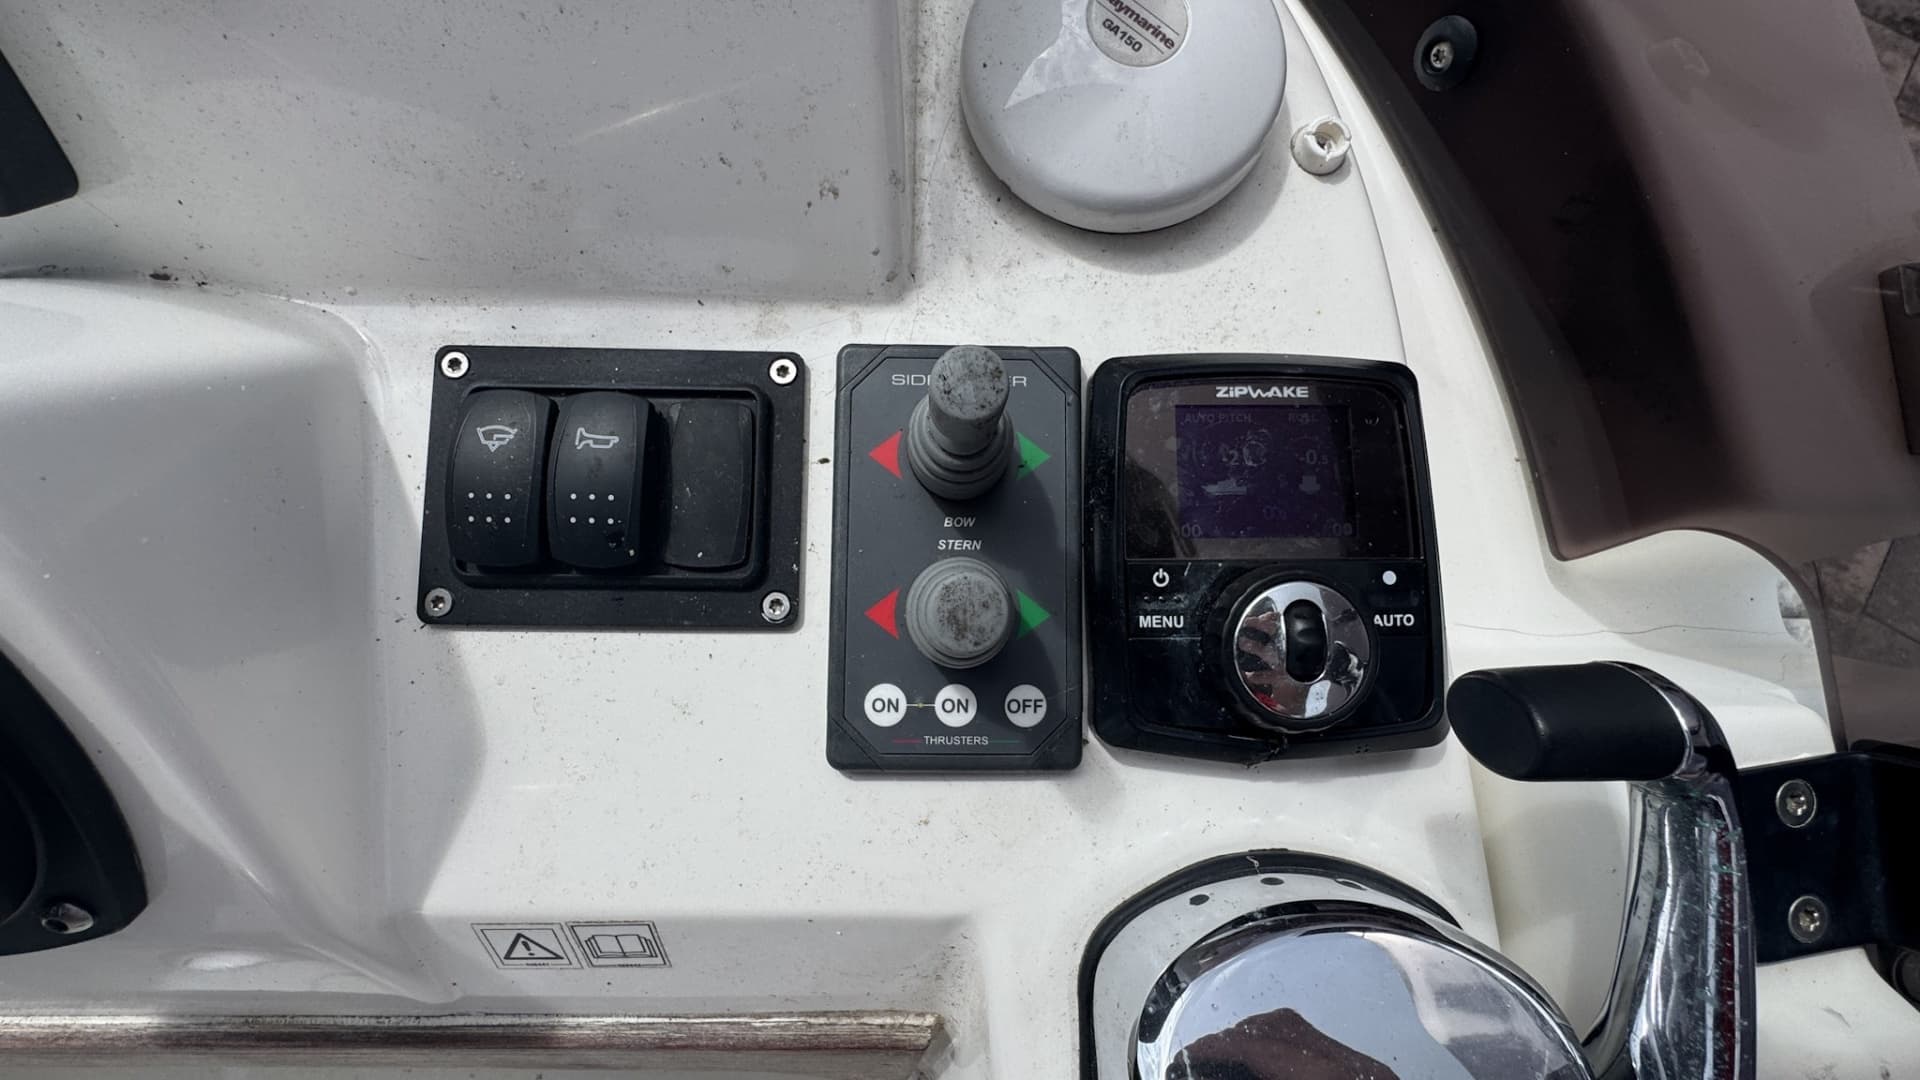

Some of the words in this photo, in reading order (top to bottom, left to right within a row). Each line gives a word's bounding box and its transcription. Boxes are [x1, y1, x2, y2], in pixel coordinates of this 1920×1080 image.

[1108, 0, 1175, 50] aymarine
[943, 516, 976, 528] BOW
[937, 539, 982, 550] STERN
[1138, 615, 1184, 628] MENU
[1374, 614, 1415, 627] AUTO
[871, 697, 900, 713] ON
[941, 698, 969, 713] ON
[1006, 698, 1044, 714] OFF
[923, 735, 989, 745] THRUSTERS
